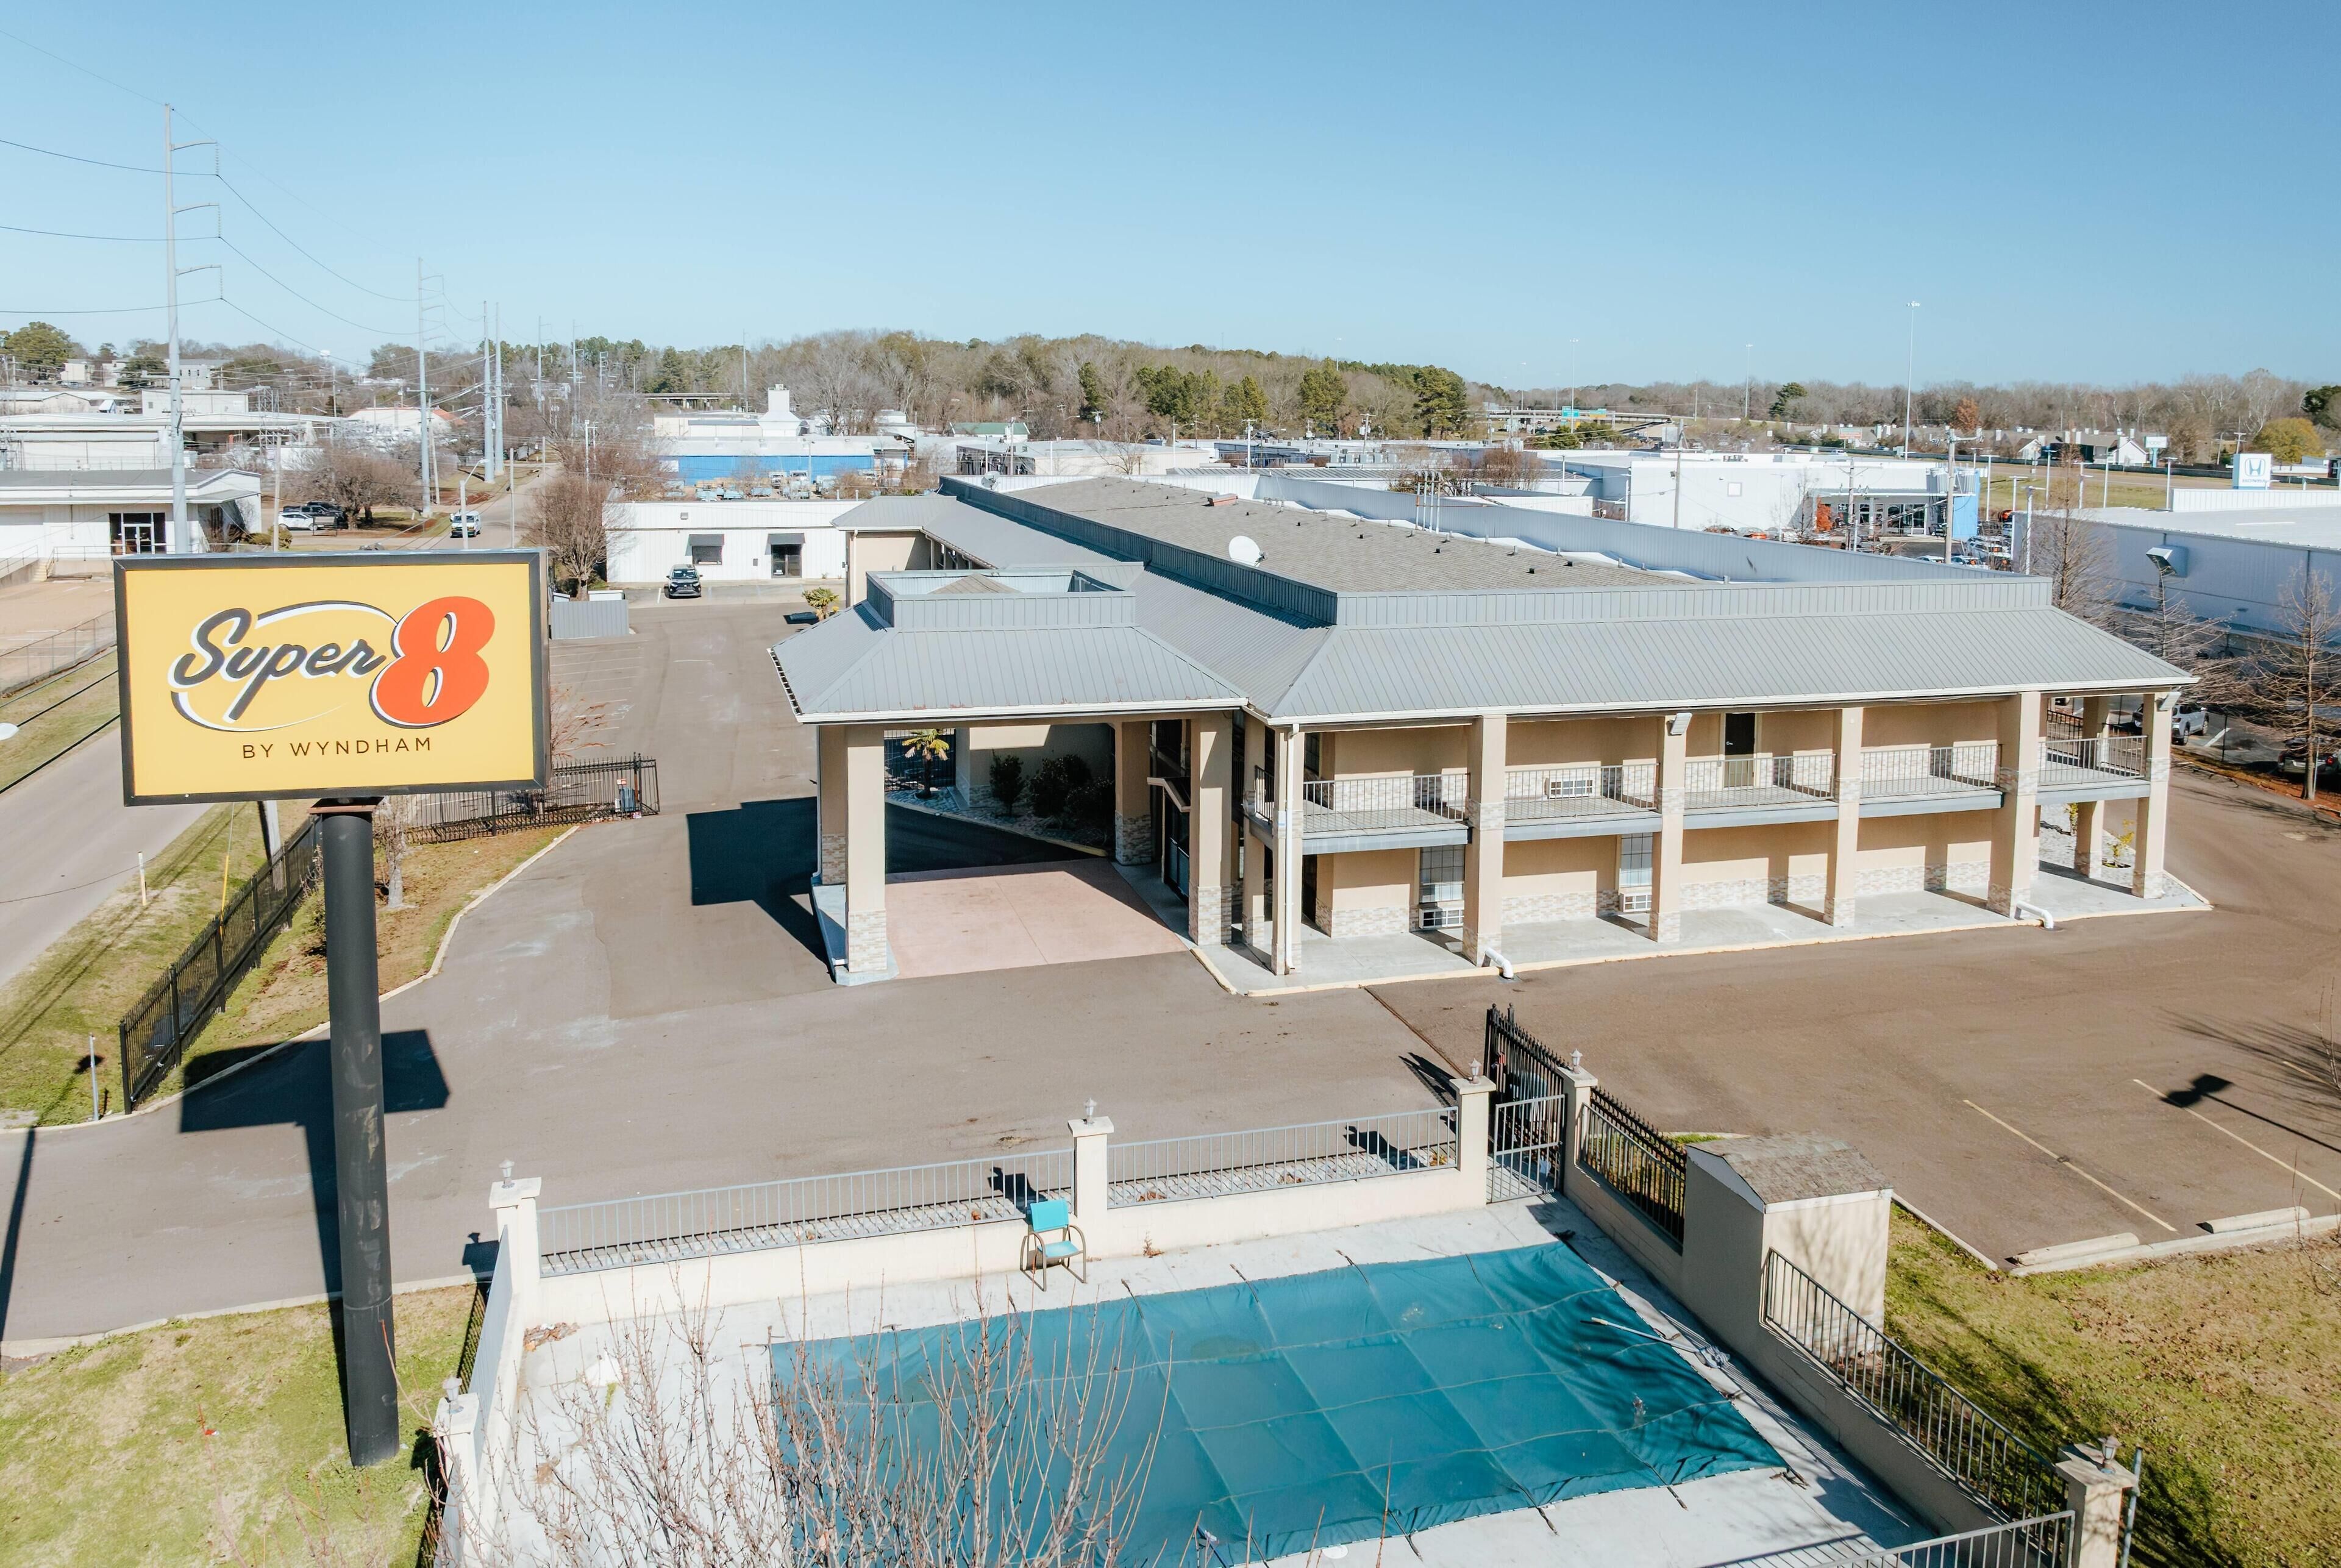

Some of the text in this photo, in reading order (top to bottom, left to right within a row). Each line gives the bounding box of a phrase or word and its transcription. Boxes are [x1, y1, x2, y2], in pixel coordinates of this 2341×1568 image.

[168, 596, 495, 729] Super 8
[242, 737, 432, 759] BY WYNDHAM
